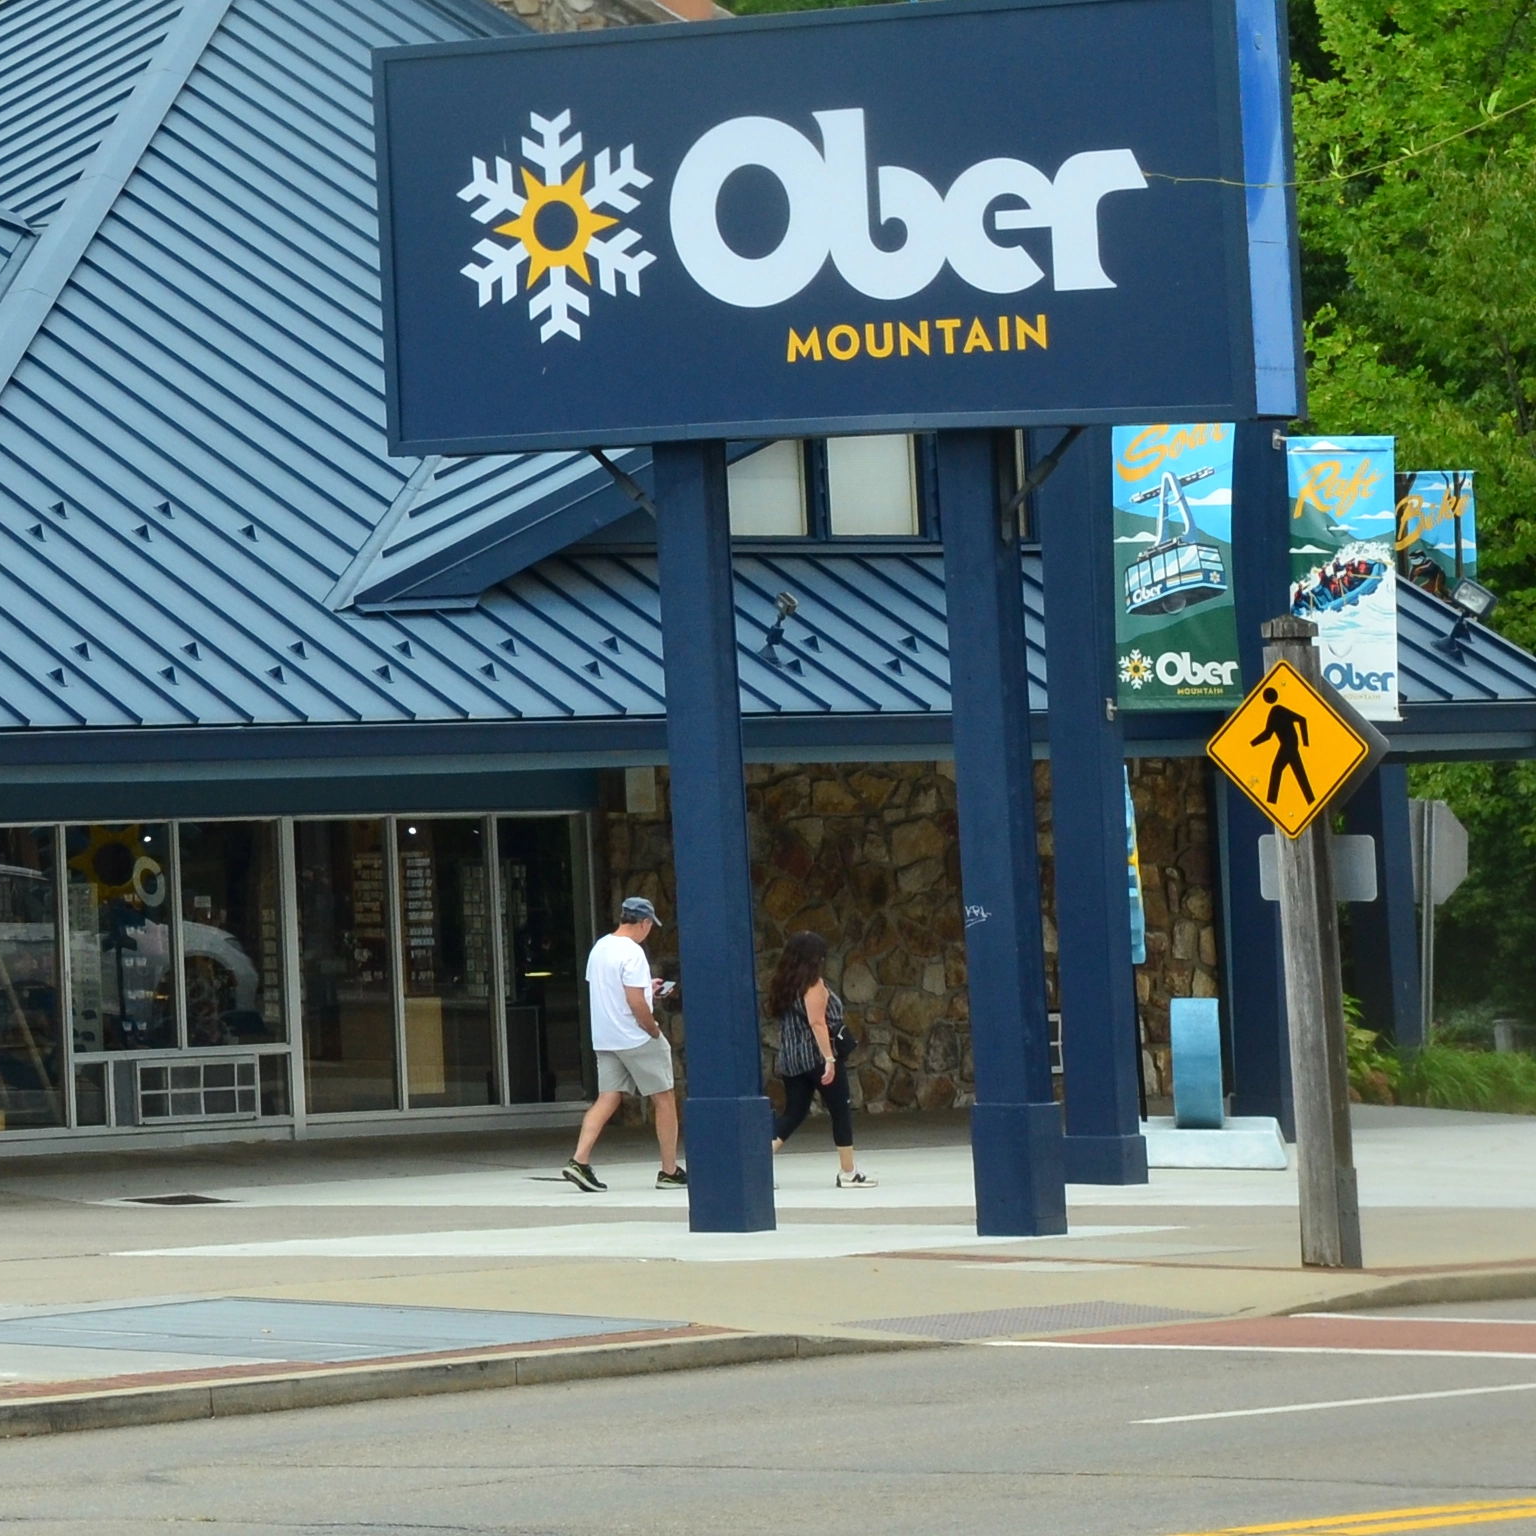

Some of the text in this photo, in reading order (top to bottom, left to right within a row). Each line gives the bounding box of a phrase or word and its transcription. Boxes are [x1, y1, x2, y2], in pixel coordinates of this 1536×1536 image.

[669, 107, 1148, 308] Ober
[786, 313, 1049, 363] MOUNTAIN
[1293, 458, 1387, 519] Raft
[1395, 486, 1471, 551] Bike
[1132, 582, 1163, 604] Ober
[1155, 651, 1239, 686] Ober
[1323, 663, 1396, 692] Ober
[1177, 687, 1224, 696] MOUNTAIN
